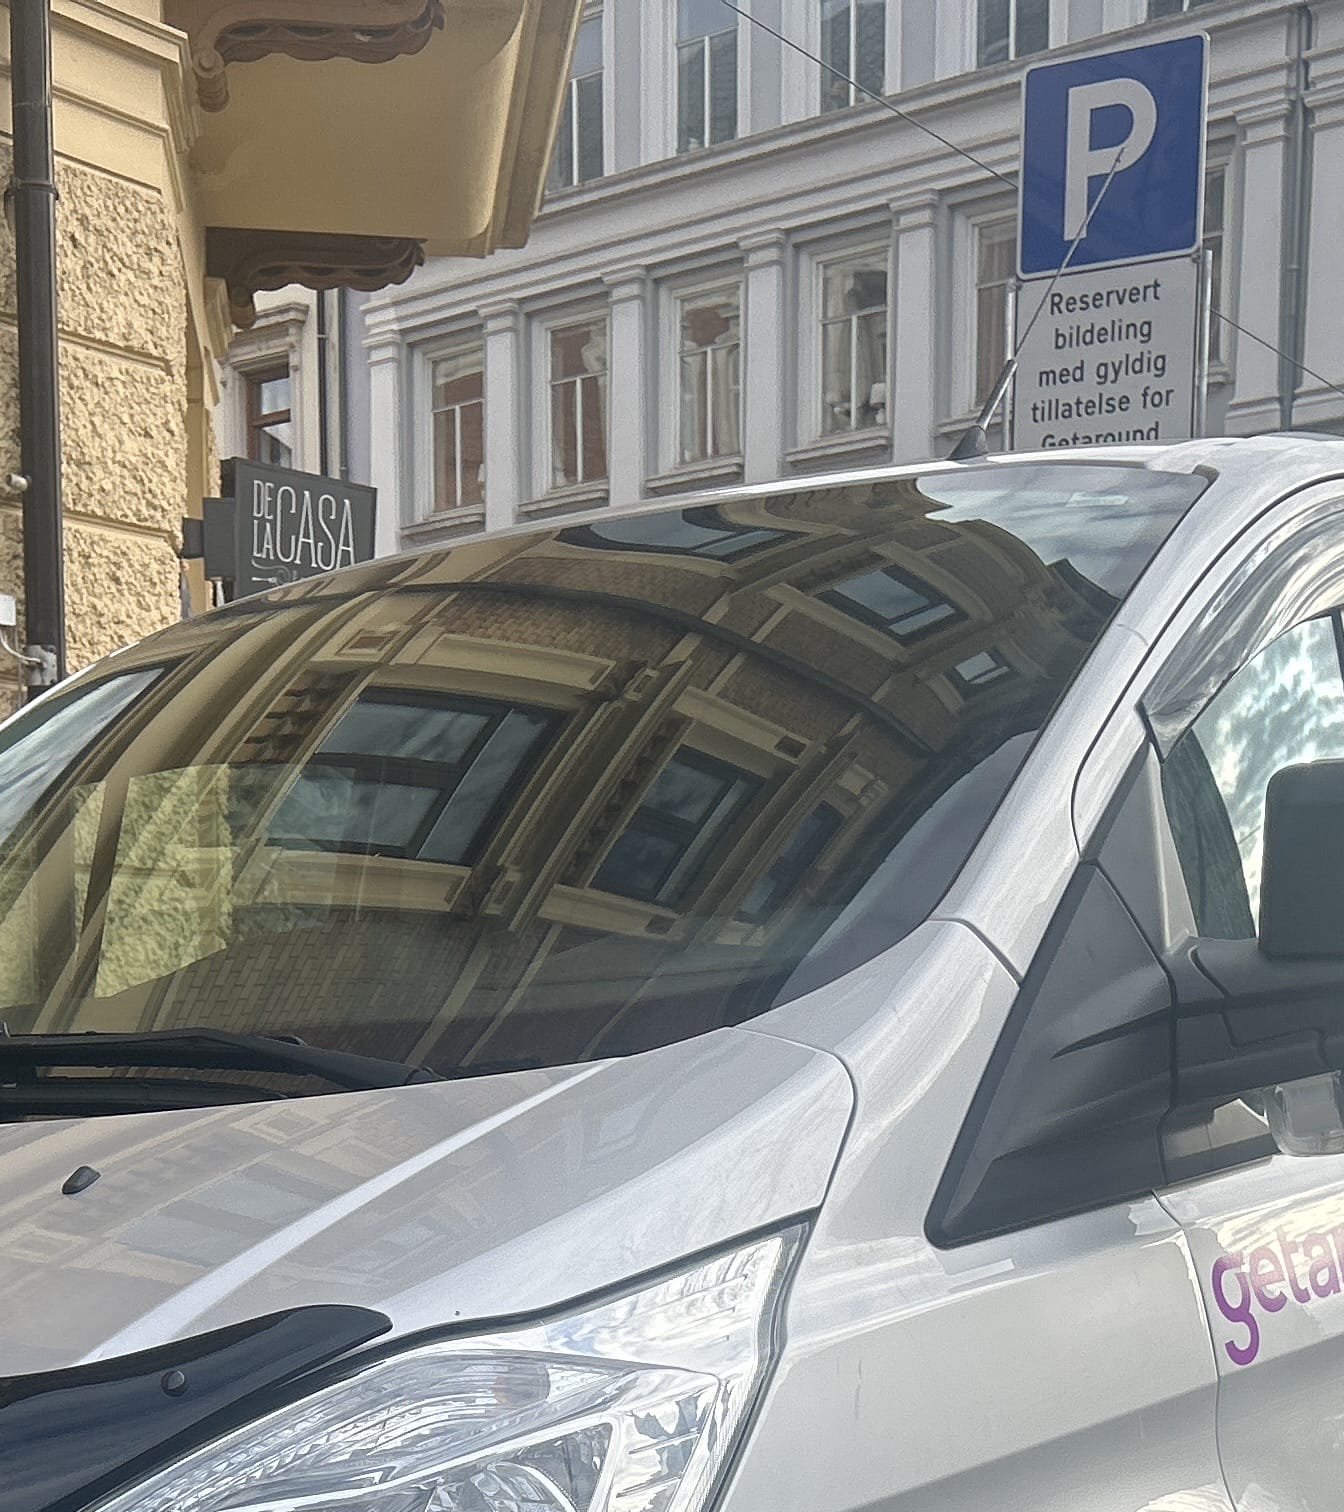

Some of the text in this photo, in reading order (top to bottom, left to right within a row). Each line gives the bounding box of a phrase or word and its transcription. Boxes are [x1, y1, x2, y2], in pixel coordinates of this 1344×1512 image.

[1064, 77, 1156, 241] P
[1050, 278, 1161, 315] Reservert
[1055, 319, 1152, 350] bildeling
[1039, 351, 1166, 387] med gyldig
[1031, 386, 1174, 423] tillatelse for
[253, 480, 274, 519] DE
[253, 486, 355, 570] LA CASA
